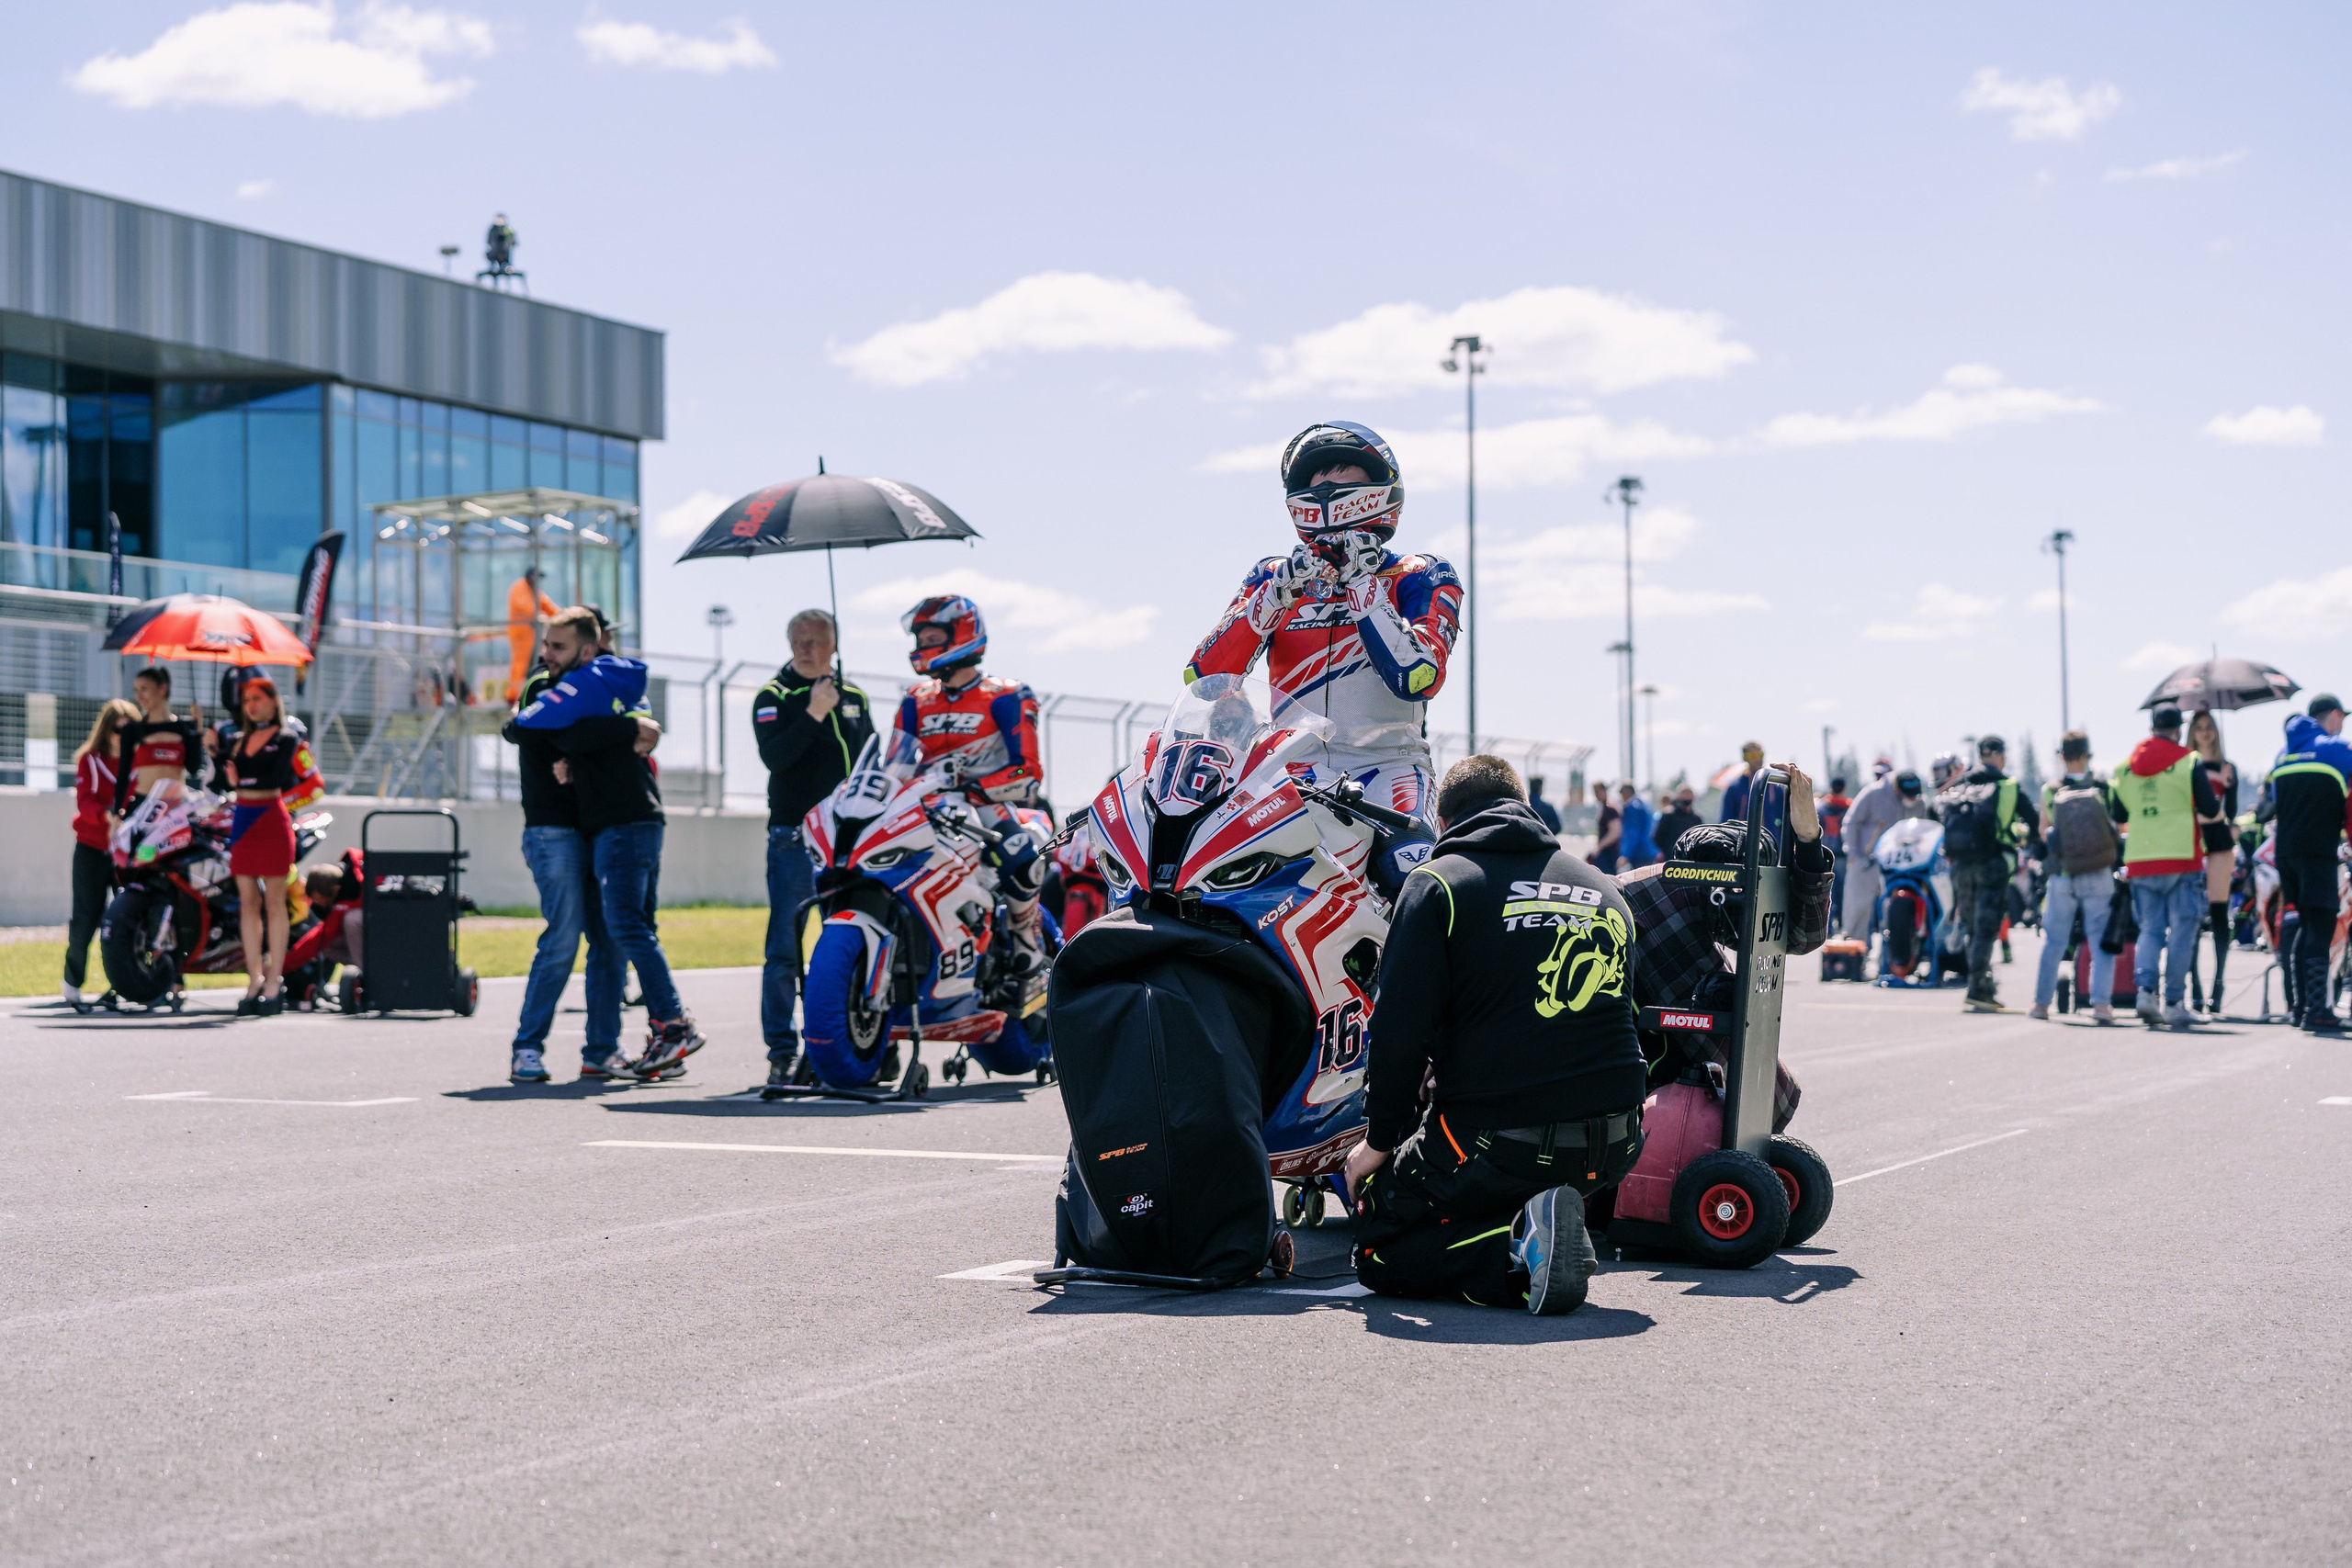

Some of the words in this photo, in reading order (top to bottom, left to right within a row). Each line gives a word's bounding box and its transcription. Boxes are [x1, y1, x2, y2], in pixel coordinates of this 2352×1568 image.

[1332, 500, 1380, 523] TEAM
[1333, 489, 1386, 513] RACING
[1290, 601, 1351, 624] SP
[1284, 621, 1335, 632] RACING
[920, 712, 985, 731] SPB
[1157, 740, 1235, 807] 16
[1102, 794, 1119, 825] MOTUL
[1247, 796, 1286, 828] MOTUL
[1664, 866, 1738, 883] GORDIYCHUK
[1507, 881, 1603, 907] SPB
[1257, 893, 1295, 931] KOST
[1510, 902, 1593, 917] RACING
[1503, 913, 1593, 932] TEAM
[1758, 911, 1785, 943] SPB
[940, 939, 977, 981] 89
[1662, 1014, 1711, 1028] MOTUL
[1317, 996, 1364, 1074] 16
[1098, 1147, 1126, 1161] SPB
[1120, 1199, 1154, 1213] capit
